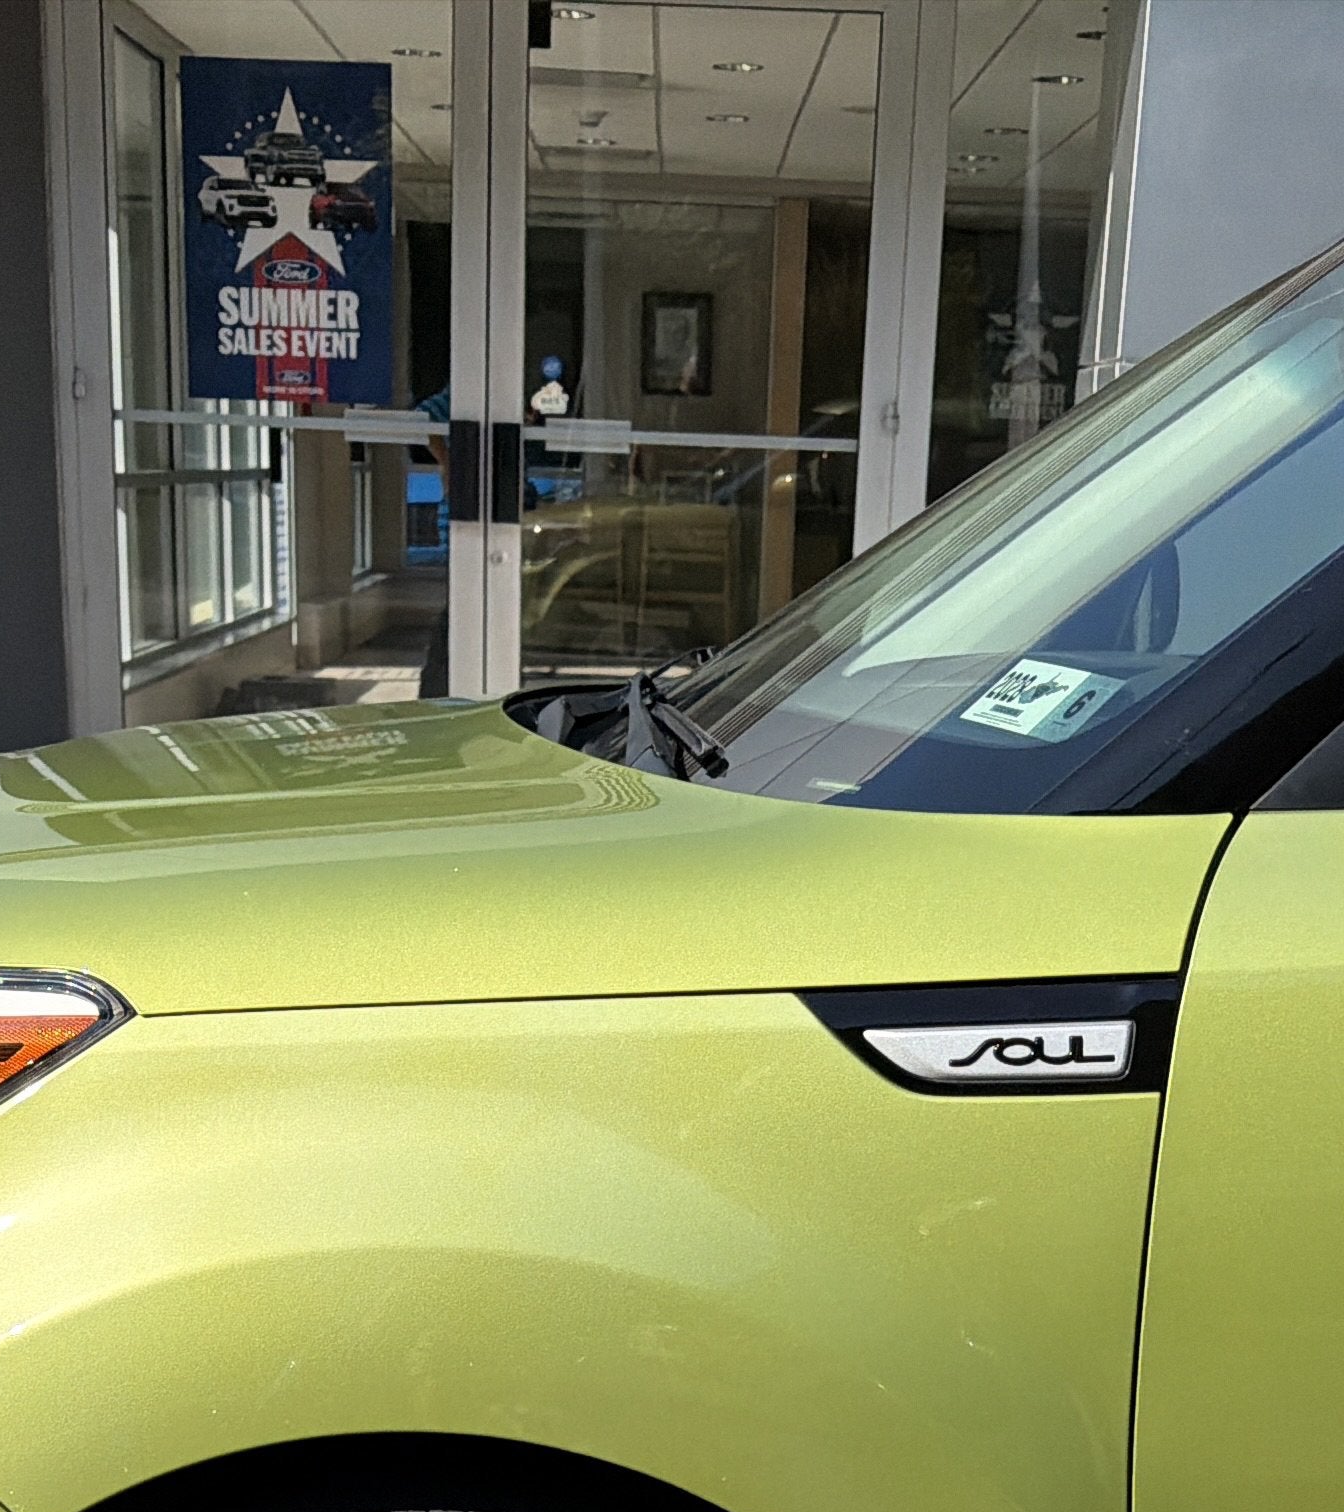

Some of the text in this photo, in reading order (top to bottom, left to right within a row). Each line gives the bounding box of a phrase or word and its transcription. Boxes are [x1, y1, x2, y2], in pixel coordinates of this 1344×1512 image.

[273, 262, 311, 280] Ford
[217, 286, 360, 329] SUMMER
[217, 327, 360, 360] SALES EVENT
[1062, 689, 1097, 719] 6
[948, 1034, 1116, 1068] SOUL
